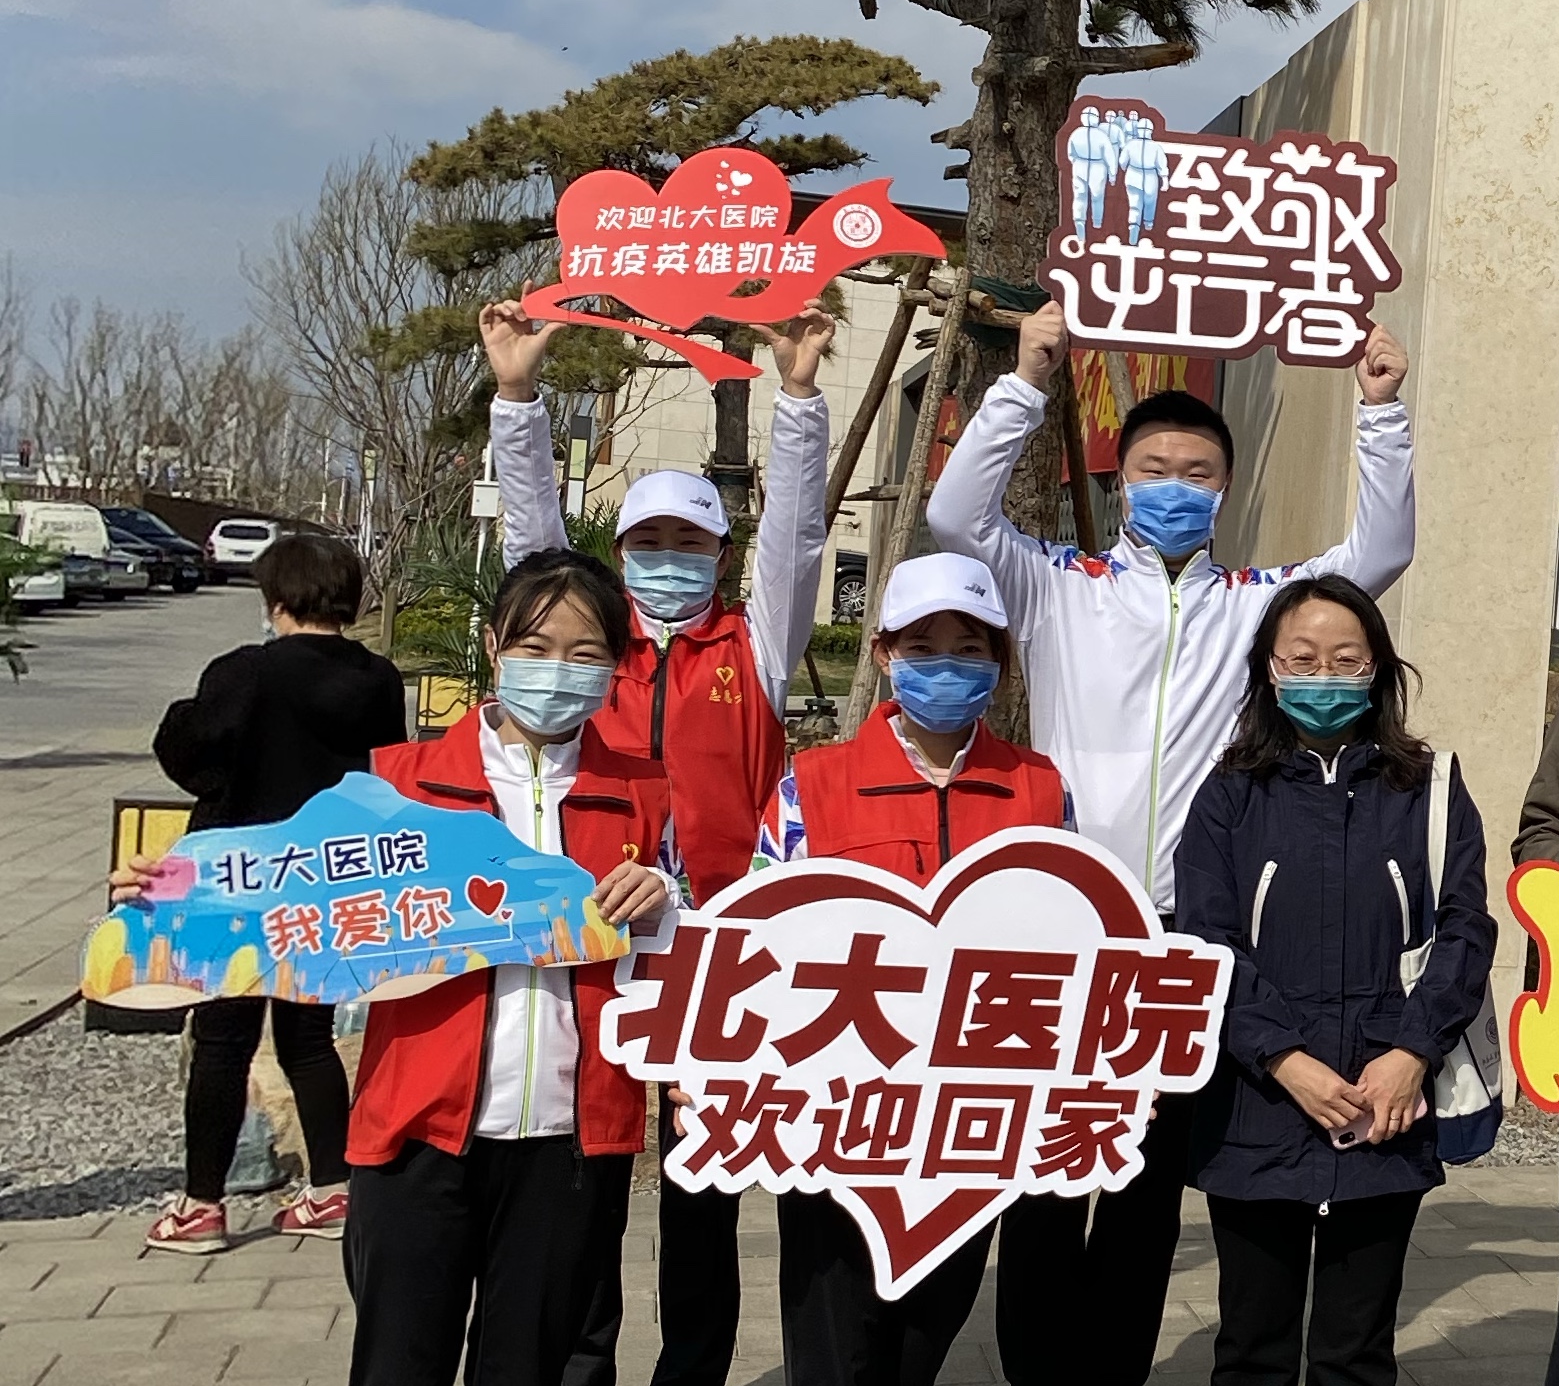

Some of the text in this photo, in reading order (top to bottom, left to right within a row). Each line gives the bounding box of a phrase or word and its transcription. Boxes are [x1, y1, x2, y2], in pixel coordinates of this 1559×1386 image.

[594, 204, 779, 232] 欢迎北大医院
[1151, 142, 1390, 281] 致敬
[567, 241, 818, 278] 抗疫英雄凯旋
[1049, 235, 1367, 357] 逆行者
[216, 830, 428, 894] 北大医院
[263, 887, 454, 960] 我爱你
[617, 925, 1221, 1079] 北大医院
[682, 1072, 1140, 1182] 欢迎回家
